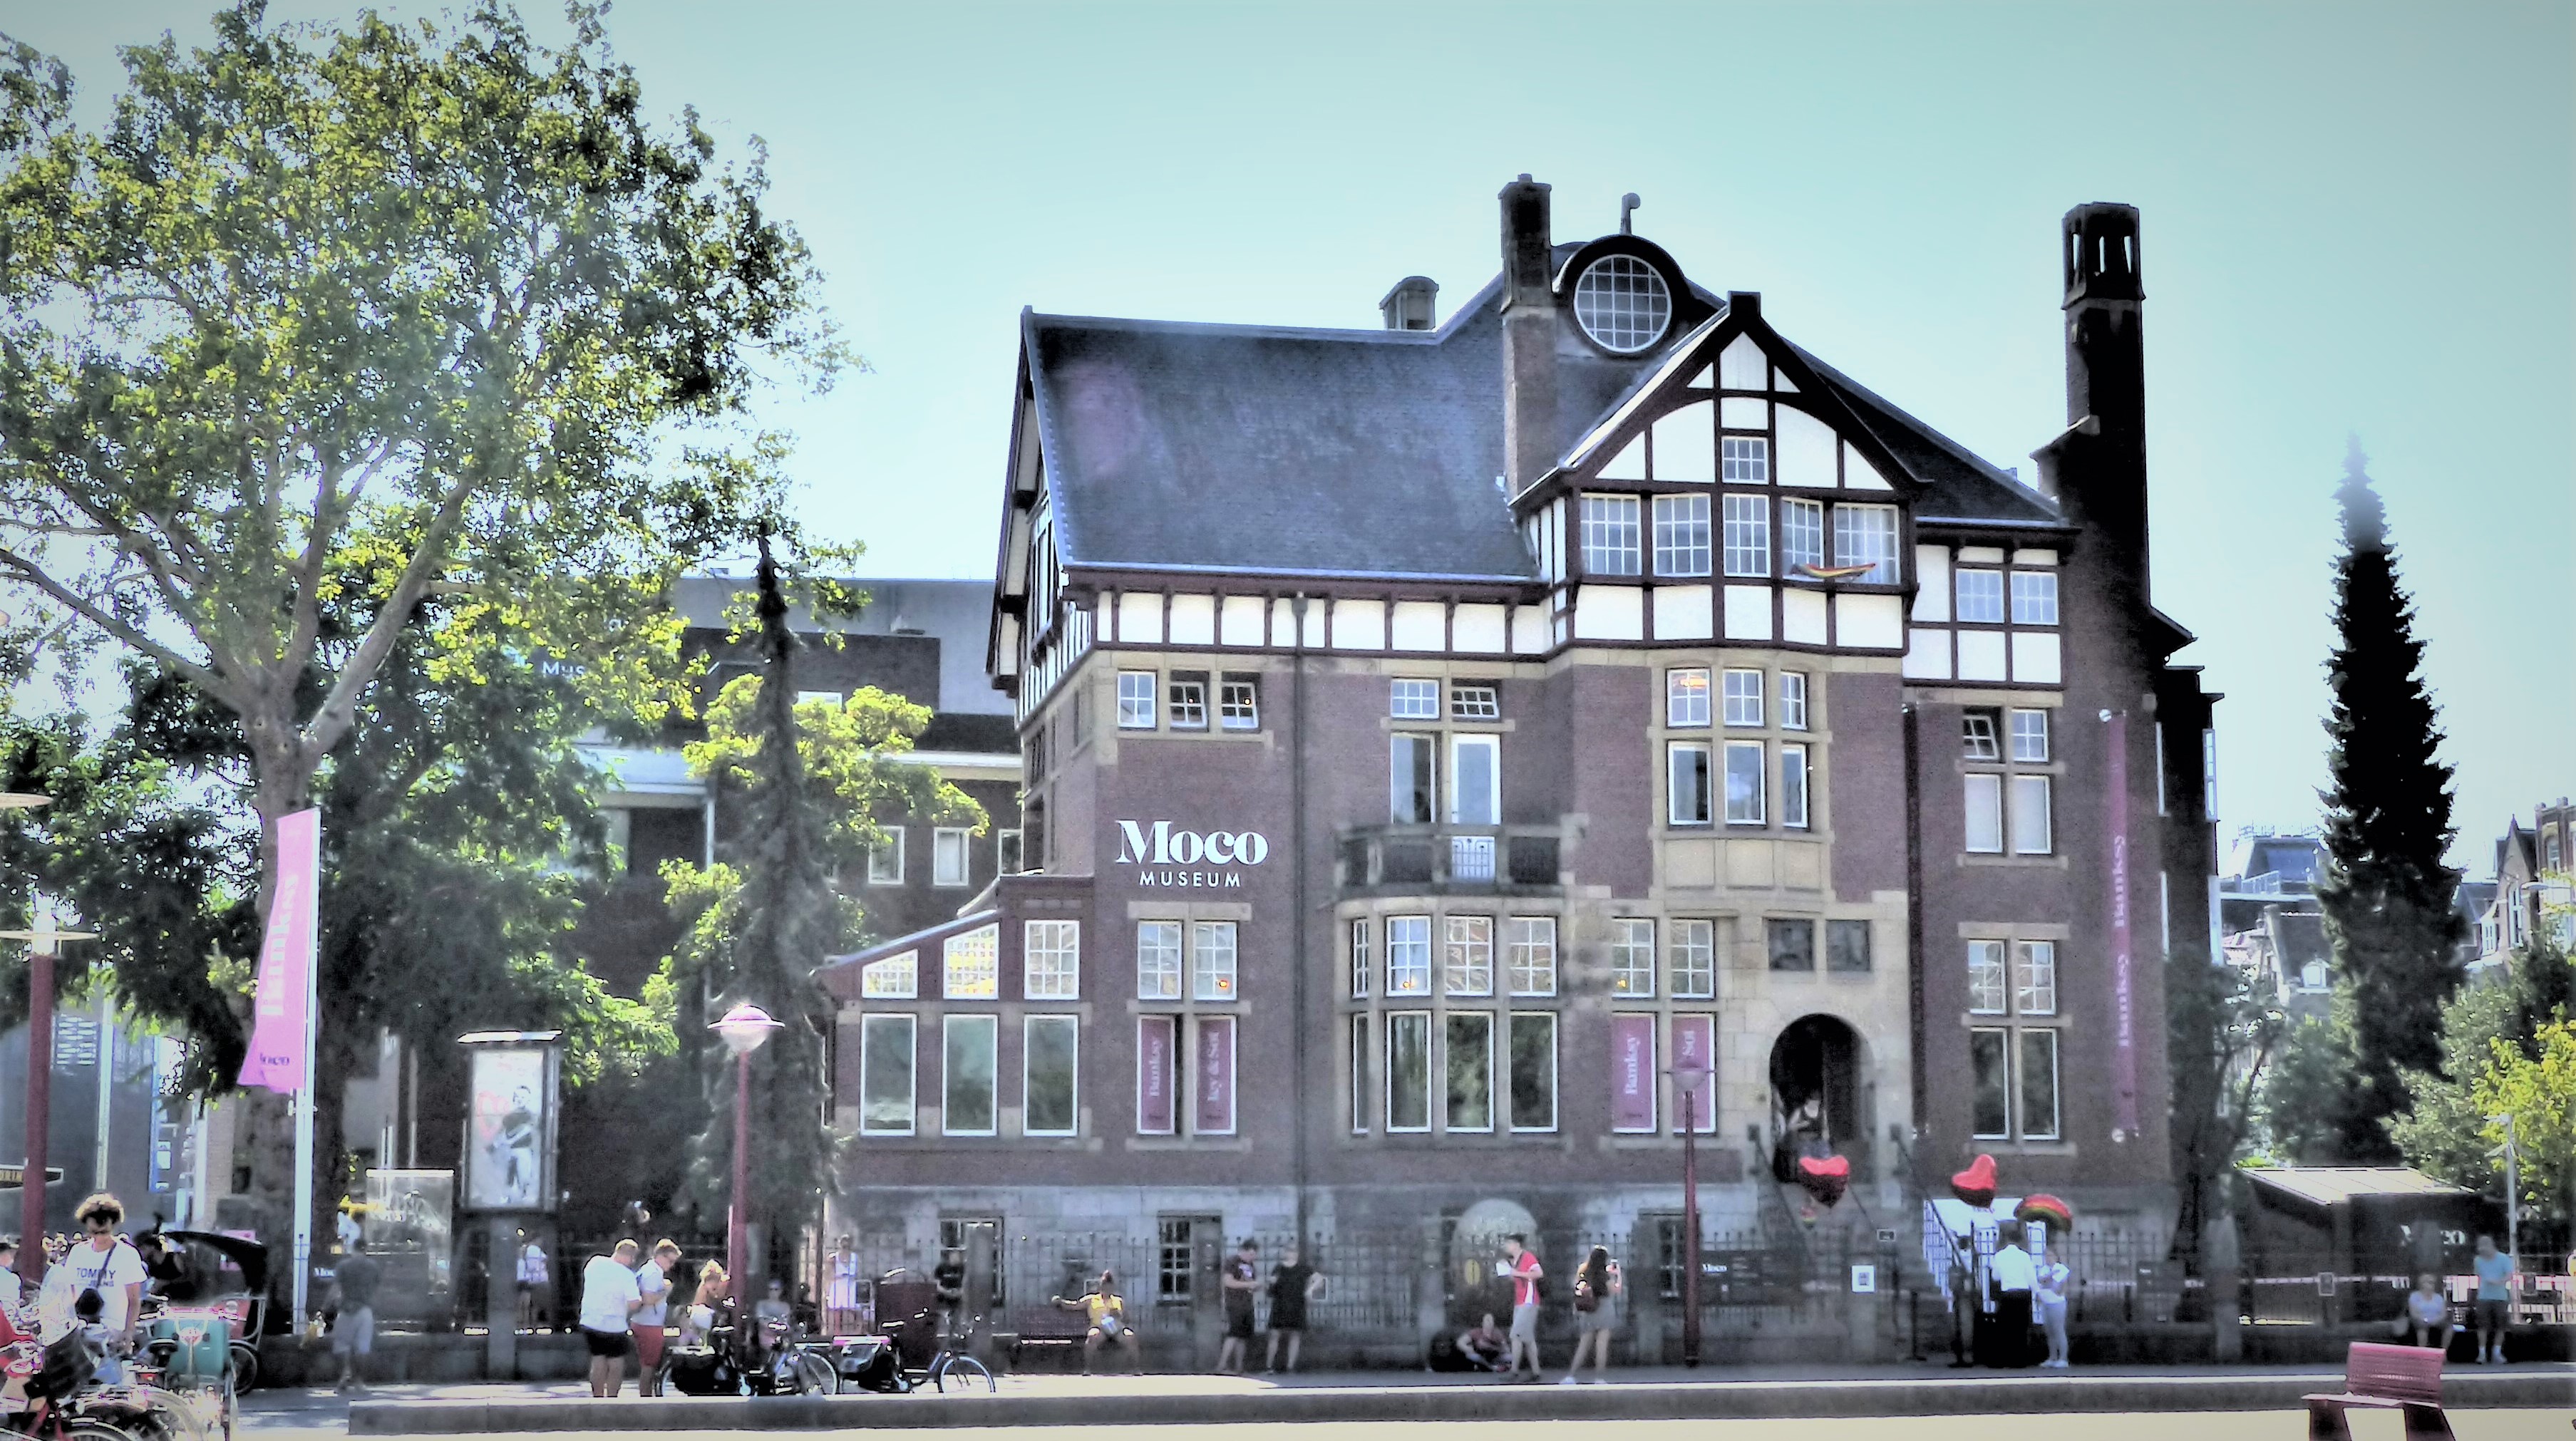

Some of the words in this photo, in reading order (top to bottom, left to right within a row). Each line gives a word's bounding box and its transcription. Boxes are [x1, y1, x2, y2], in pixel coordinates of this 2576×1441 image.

[1115, 819, 1269, 866] Moco
[1138, 871, 1242, 888] MUSEUM
[1623, 1035, 1641, 1095] Banksy
